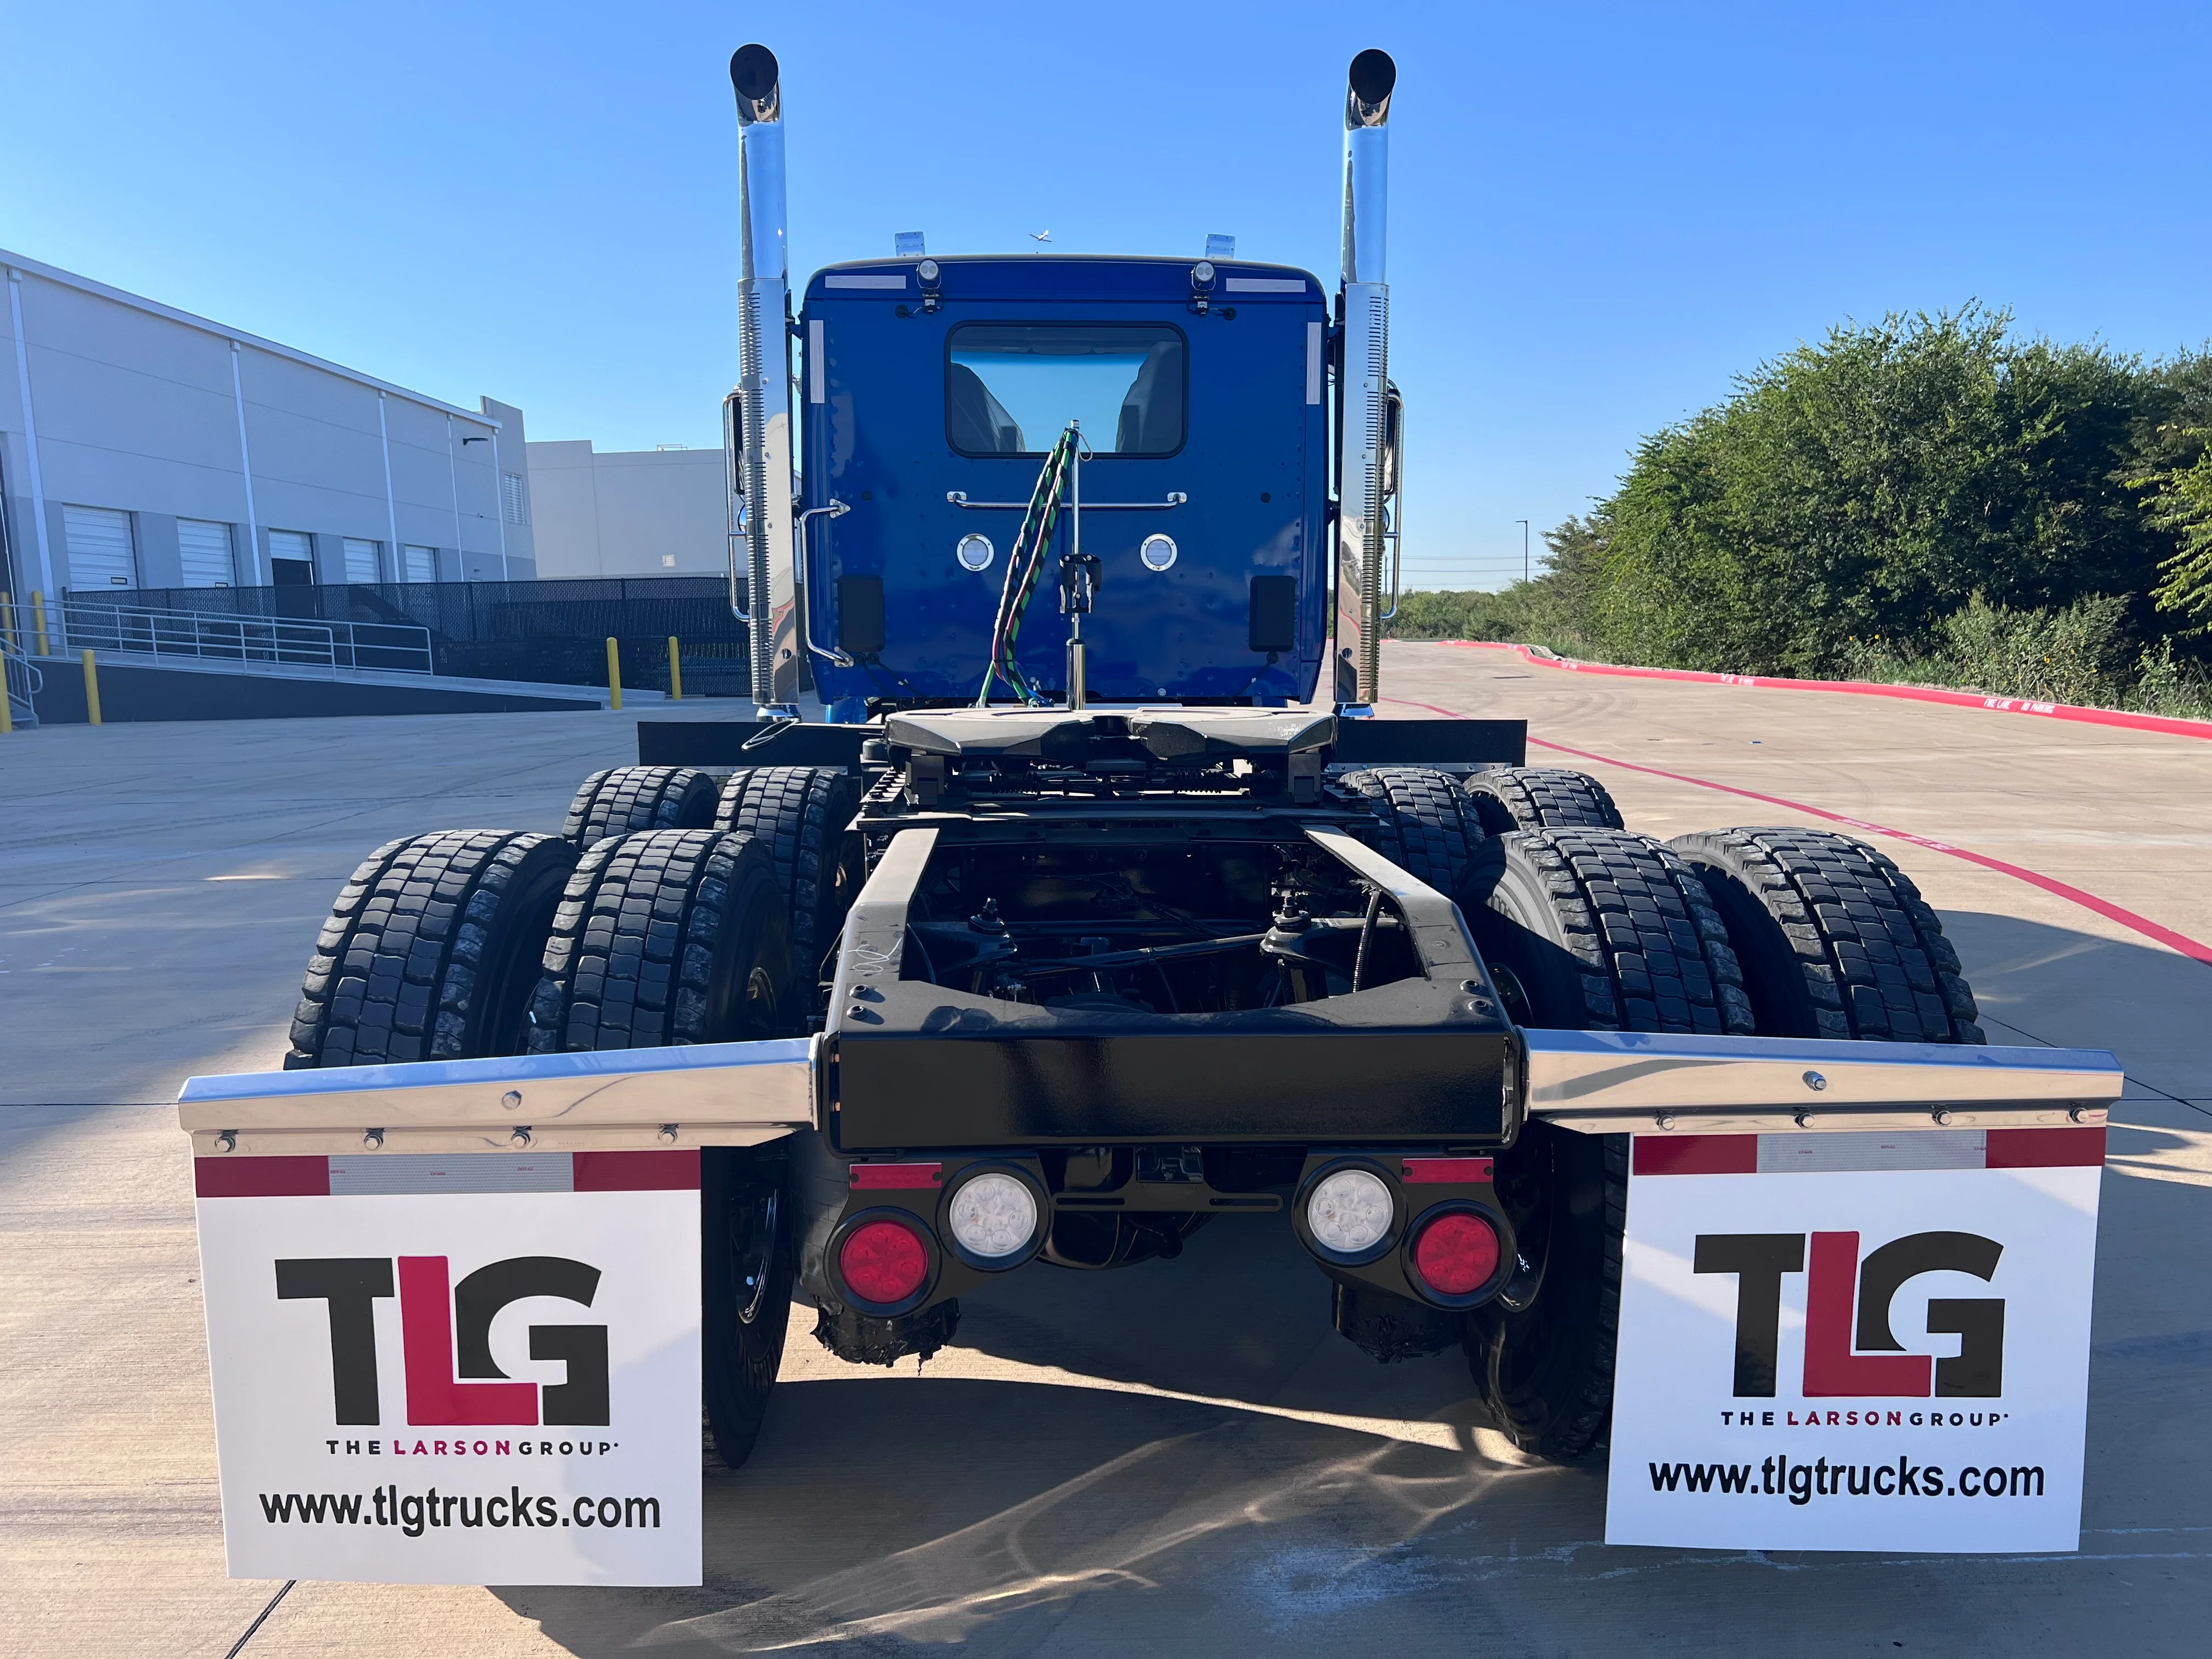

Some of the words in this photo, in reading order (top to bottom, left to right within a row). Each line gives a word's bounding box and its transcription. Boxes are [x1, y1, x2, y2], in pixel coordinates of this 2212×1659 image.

[1996, 698, 2013, 710] LANE
[2020, 702, 2031, 712] NO
[2029, 703, 2057, 714] PARKING
[1694, 1231, 2005, 1397] TLG
[275, 1256, 610, 1426] TLG
[1721, 1412, 1774, 1426] THE
[326, 1440, 380, 1454] THE
[1649, 1455, 2044, 1505] www.tlgtrucks.com
[259, 1485, 660, 1537] www.tlgtrucks.com
